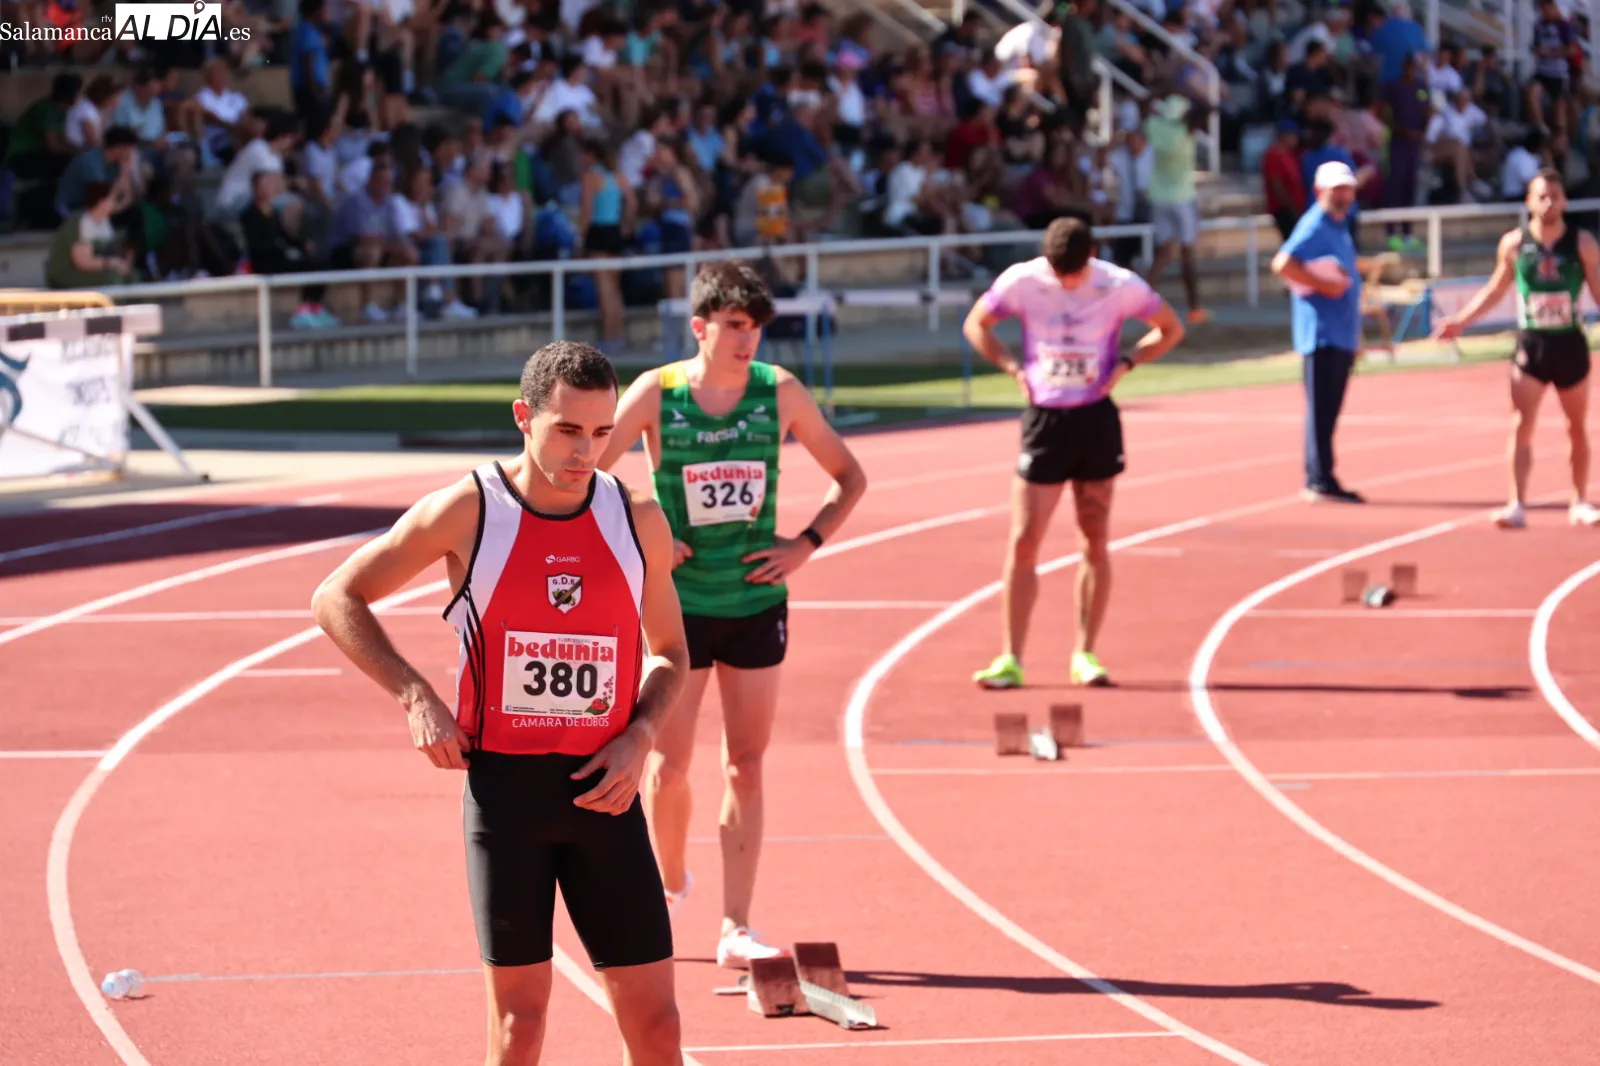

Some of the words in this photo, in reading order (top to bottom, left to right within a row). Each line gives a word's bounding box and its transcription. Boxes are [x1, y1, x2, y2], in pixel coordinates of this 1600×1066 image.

[686, 464, 764, 484] bedunia
[701, 481, 754, 509] 326
[507, 636, 614, 663] bedunia
[523, 660, 598, 699] 380
[565, 716, 579, 727] DE
[581, 717, 610, 727] LOBOS
